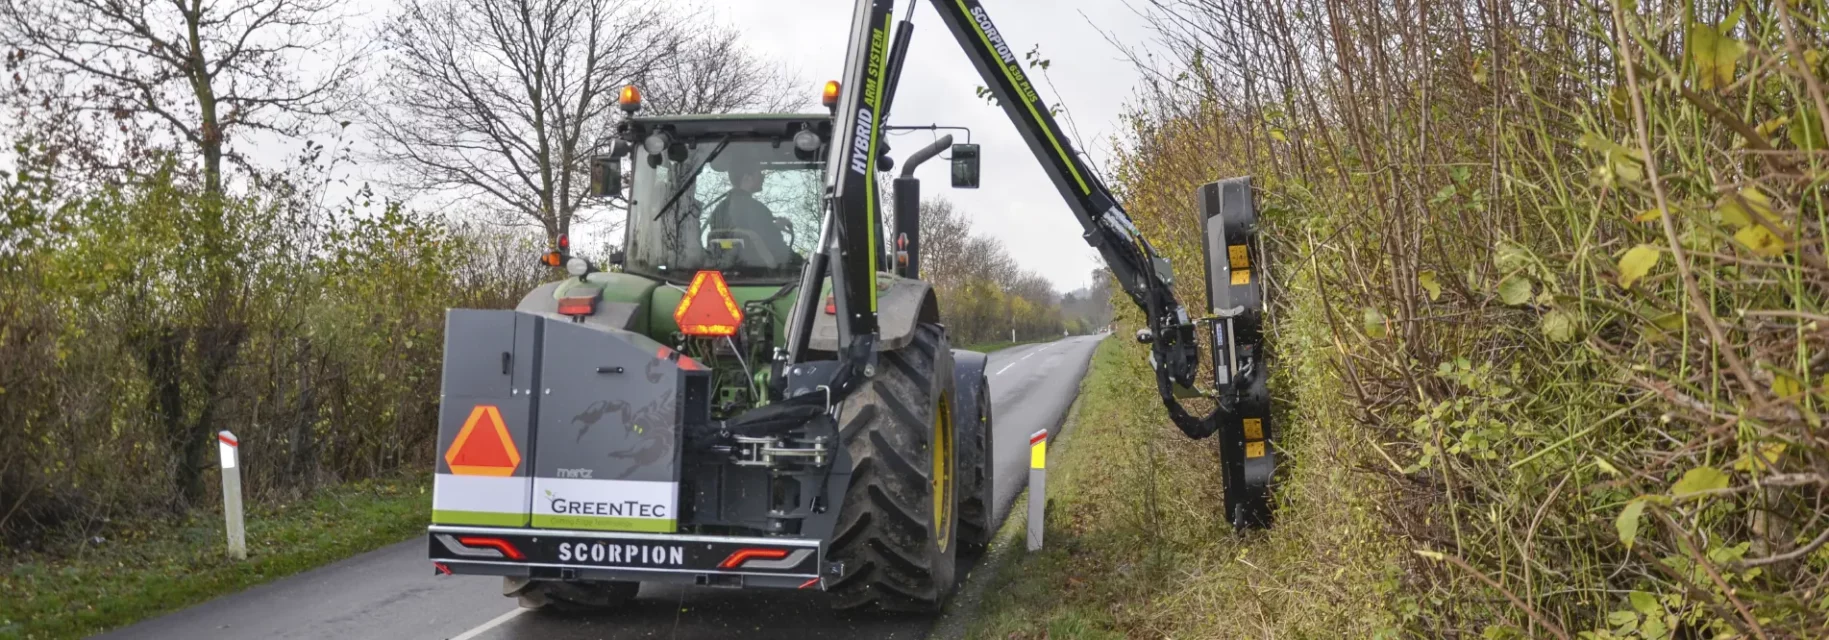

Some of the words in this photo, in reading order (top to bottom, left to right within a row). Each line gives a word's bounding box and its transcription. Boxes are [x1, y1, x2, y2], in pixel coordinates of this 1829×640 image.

[868, 28, 883, 77] SYSTEM
[970, 6, 1014, 64] SCORPION
[1009, 64, 1023, 82] 630
[1020, 80, 1038, 103] PLUS
[864, 78, 876, 107] ARM
[851, 108, 872, 175] HYBRID
[558, 542, 683, 565] SCORPION
